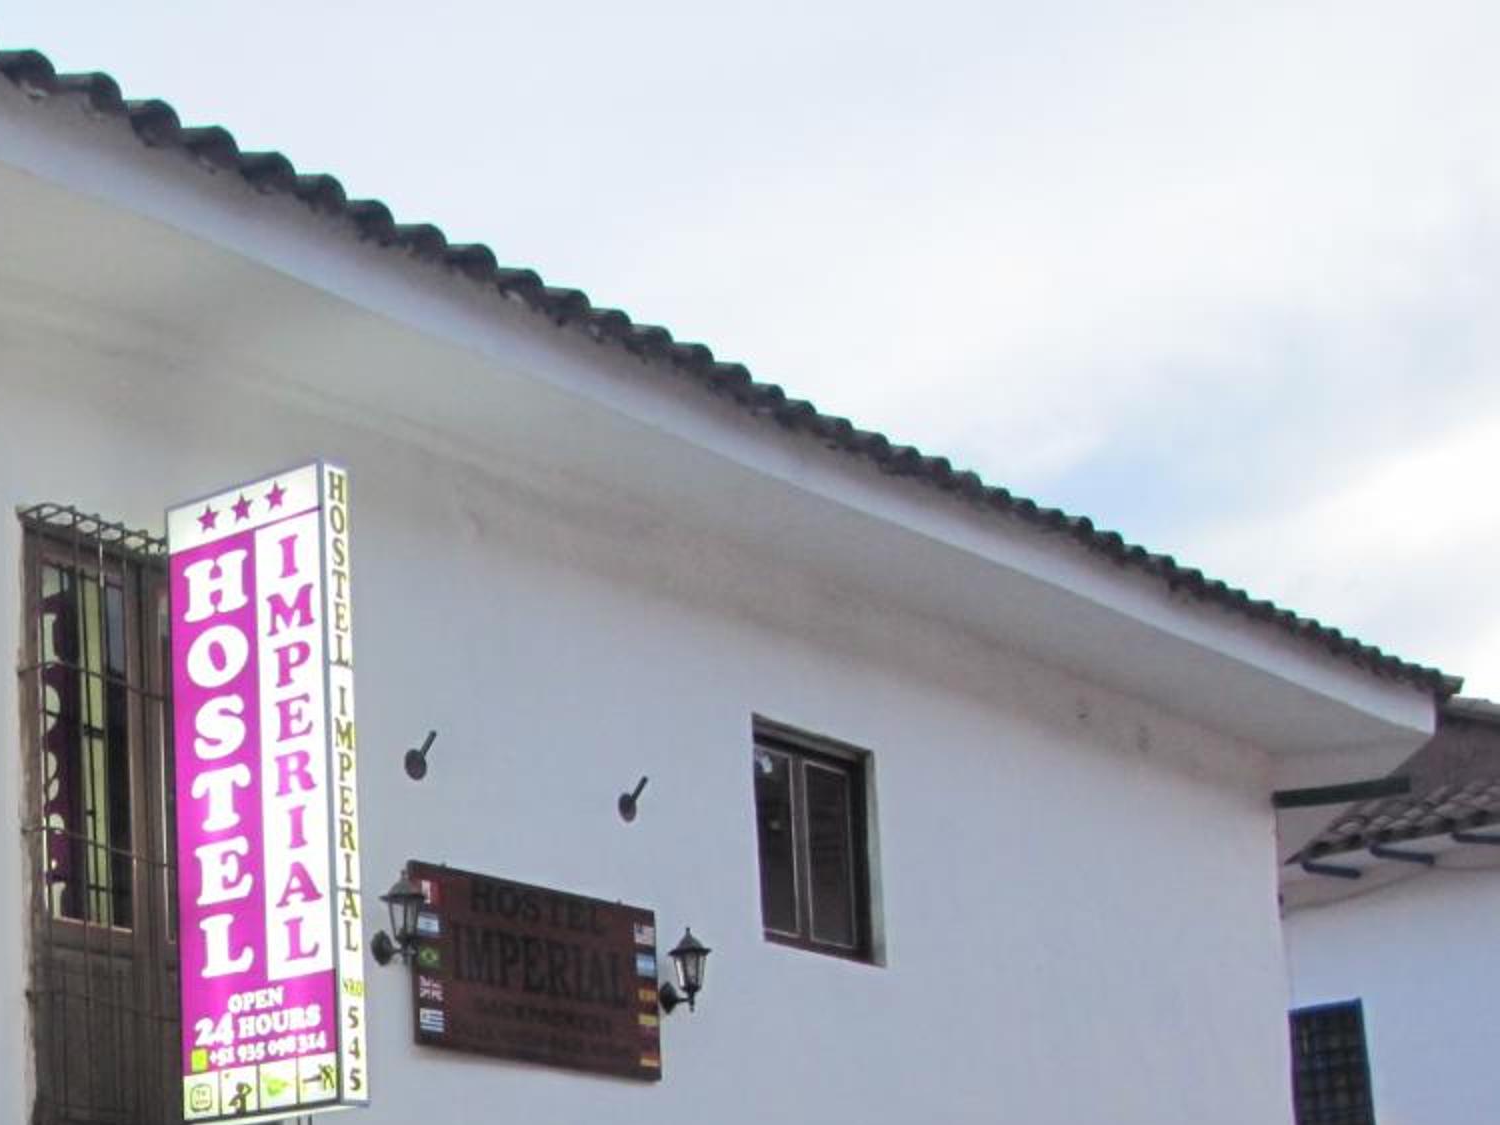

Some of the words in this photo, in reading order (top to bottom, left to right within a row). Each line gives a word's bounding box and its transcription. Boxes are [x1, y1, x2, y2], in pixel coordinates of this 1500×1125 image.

[328, 471, 353, 669] HOSTEL
[183, 548, 254, 978] HOSTEL
[266, 533, 324, 961] IMPERIAL
[334, 686, 359, 952] IMPERIAL
[194, 1012, 235, 1046] 24
[237, 1004, 322, 1039] HOURS
[227, 985, 285, 1014] OPEN
[346, 1006, 362, 1092] 545
